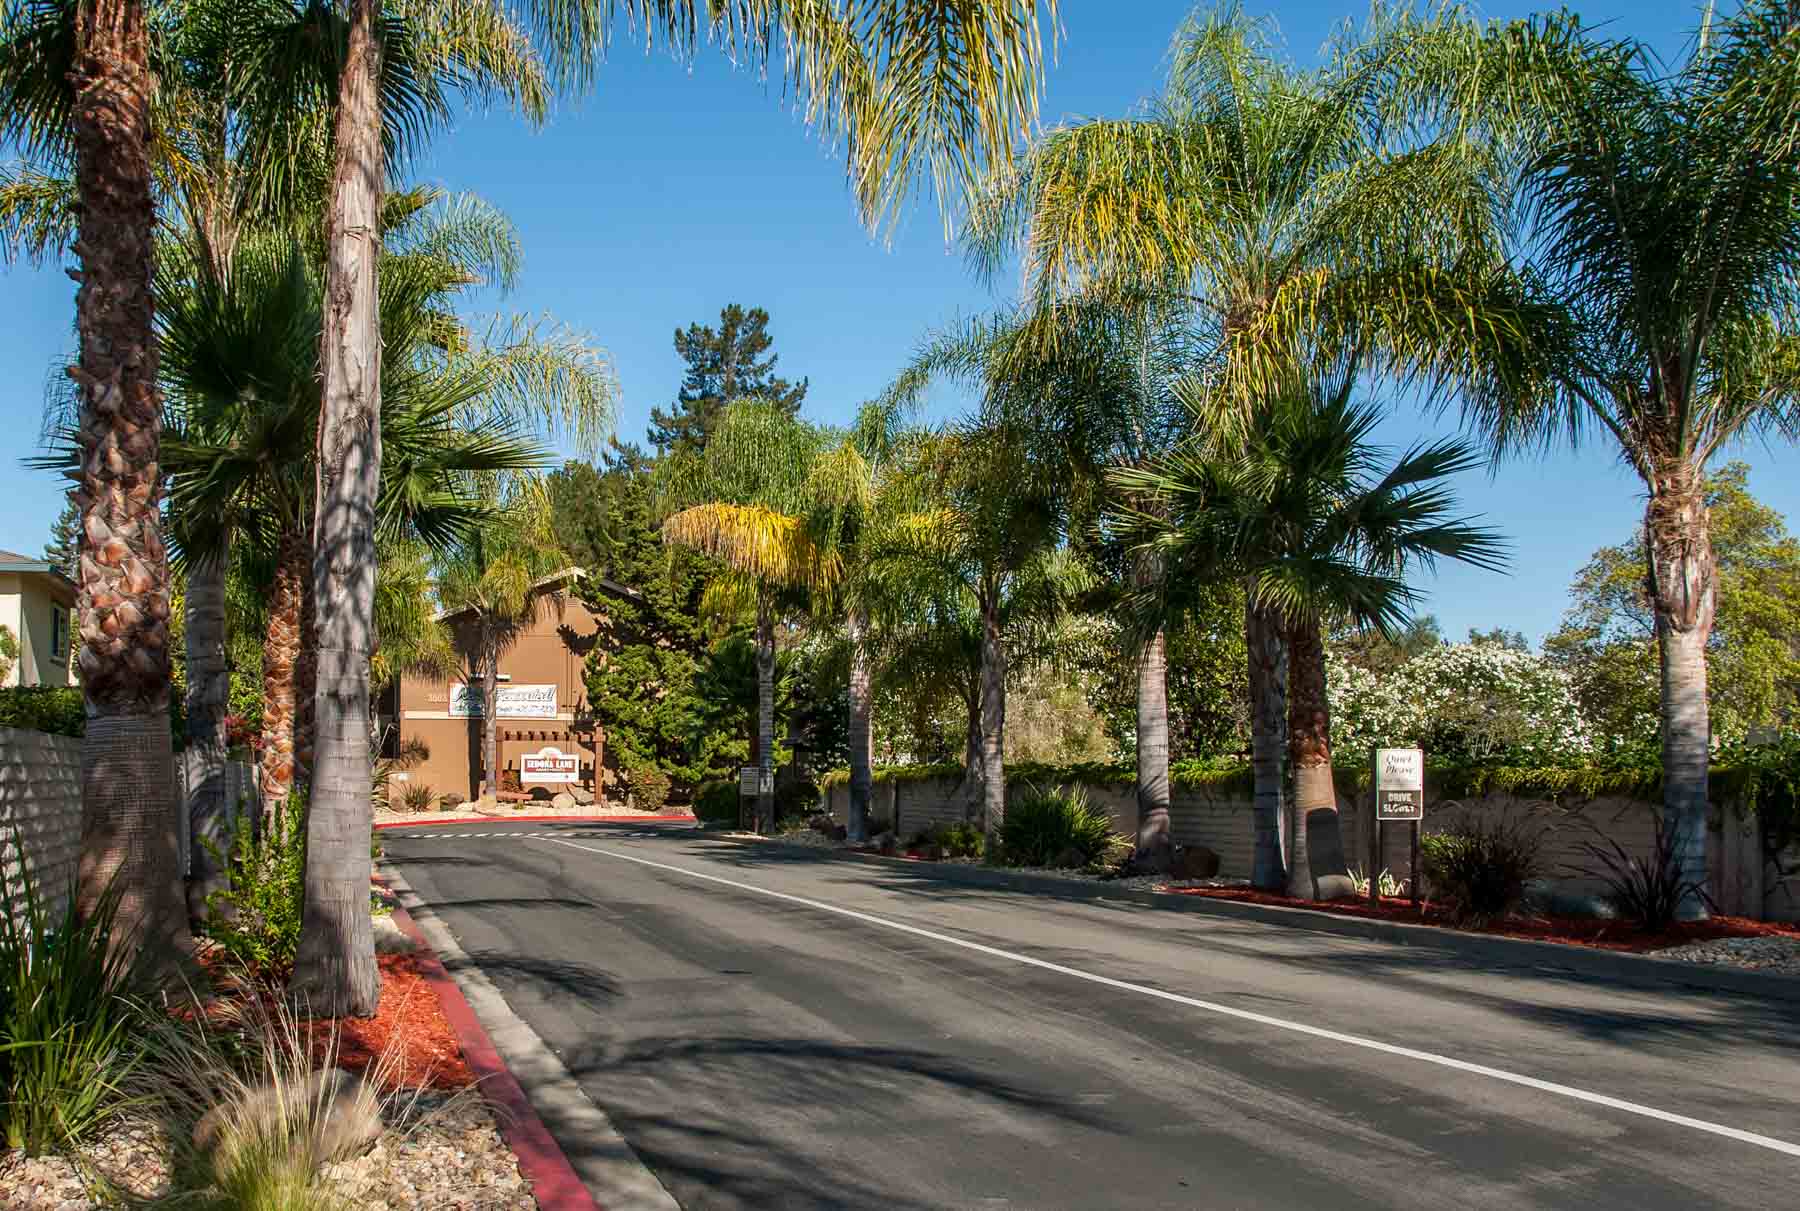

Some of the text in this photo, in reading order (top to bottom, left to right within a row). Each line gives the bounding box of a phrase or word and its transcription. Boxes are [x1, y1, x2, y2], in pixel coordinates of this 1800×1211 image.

[527, 760, 573, 768] SEDONA LANE
[1385, 754, 1412, 765] Quiet
[1388, 793, 1412, 802] DRIVE
